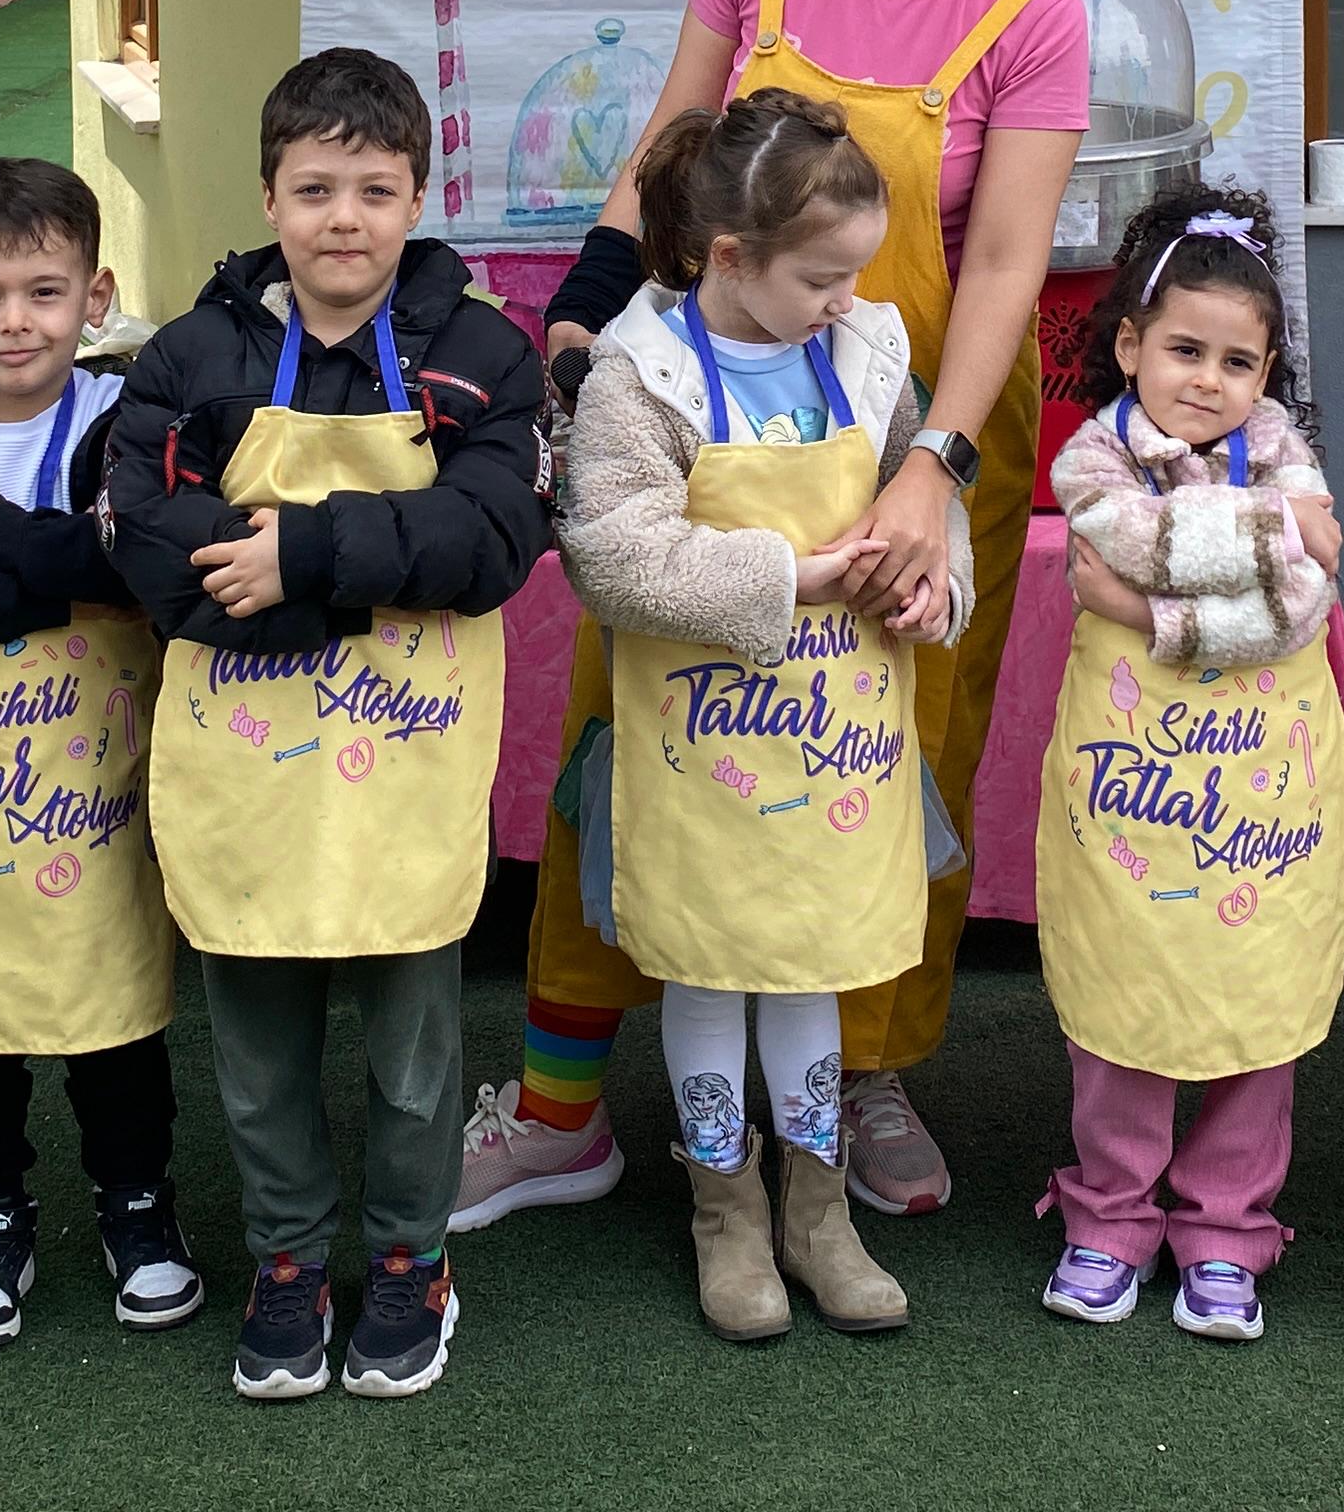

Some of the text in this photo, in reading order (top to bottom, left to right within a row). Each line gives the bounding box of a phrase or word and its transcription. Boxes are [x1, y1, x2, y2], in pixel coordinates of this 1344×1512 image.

[754, 610, 859, 668] ihirli
[314, 665, 463, 741] Atölyesi
[665, 663, 835, 744] Tatlar
[1145, 701, 1266, 758] Sihirli
[5, 776, 142, 850] Atölyesi
[1076, 740, 1232, 834] Tatlar
[1192, 808, 1324, 880] Atölyesi
